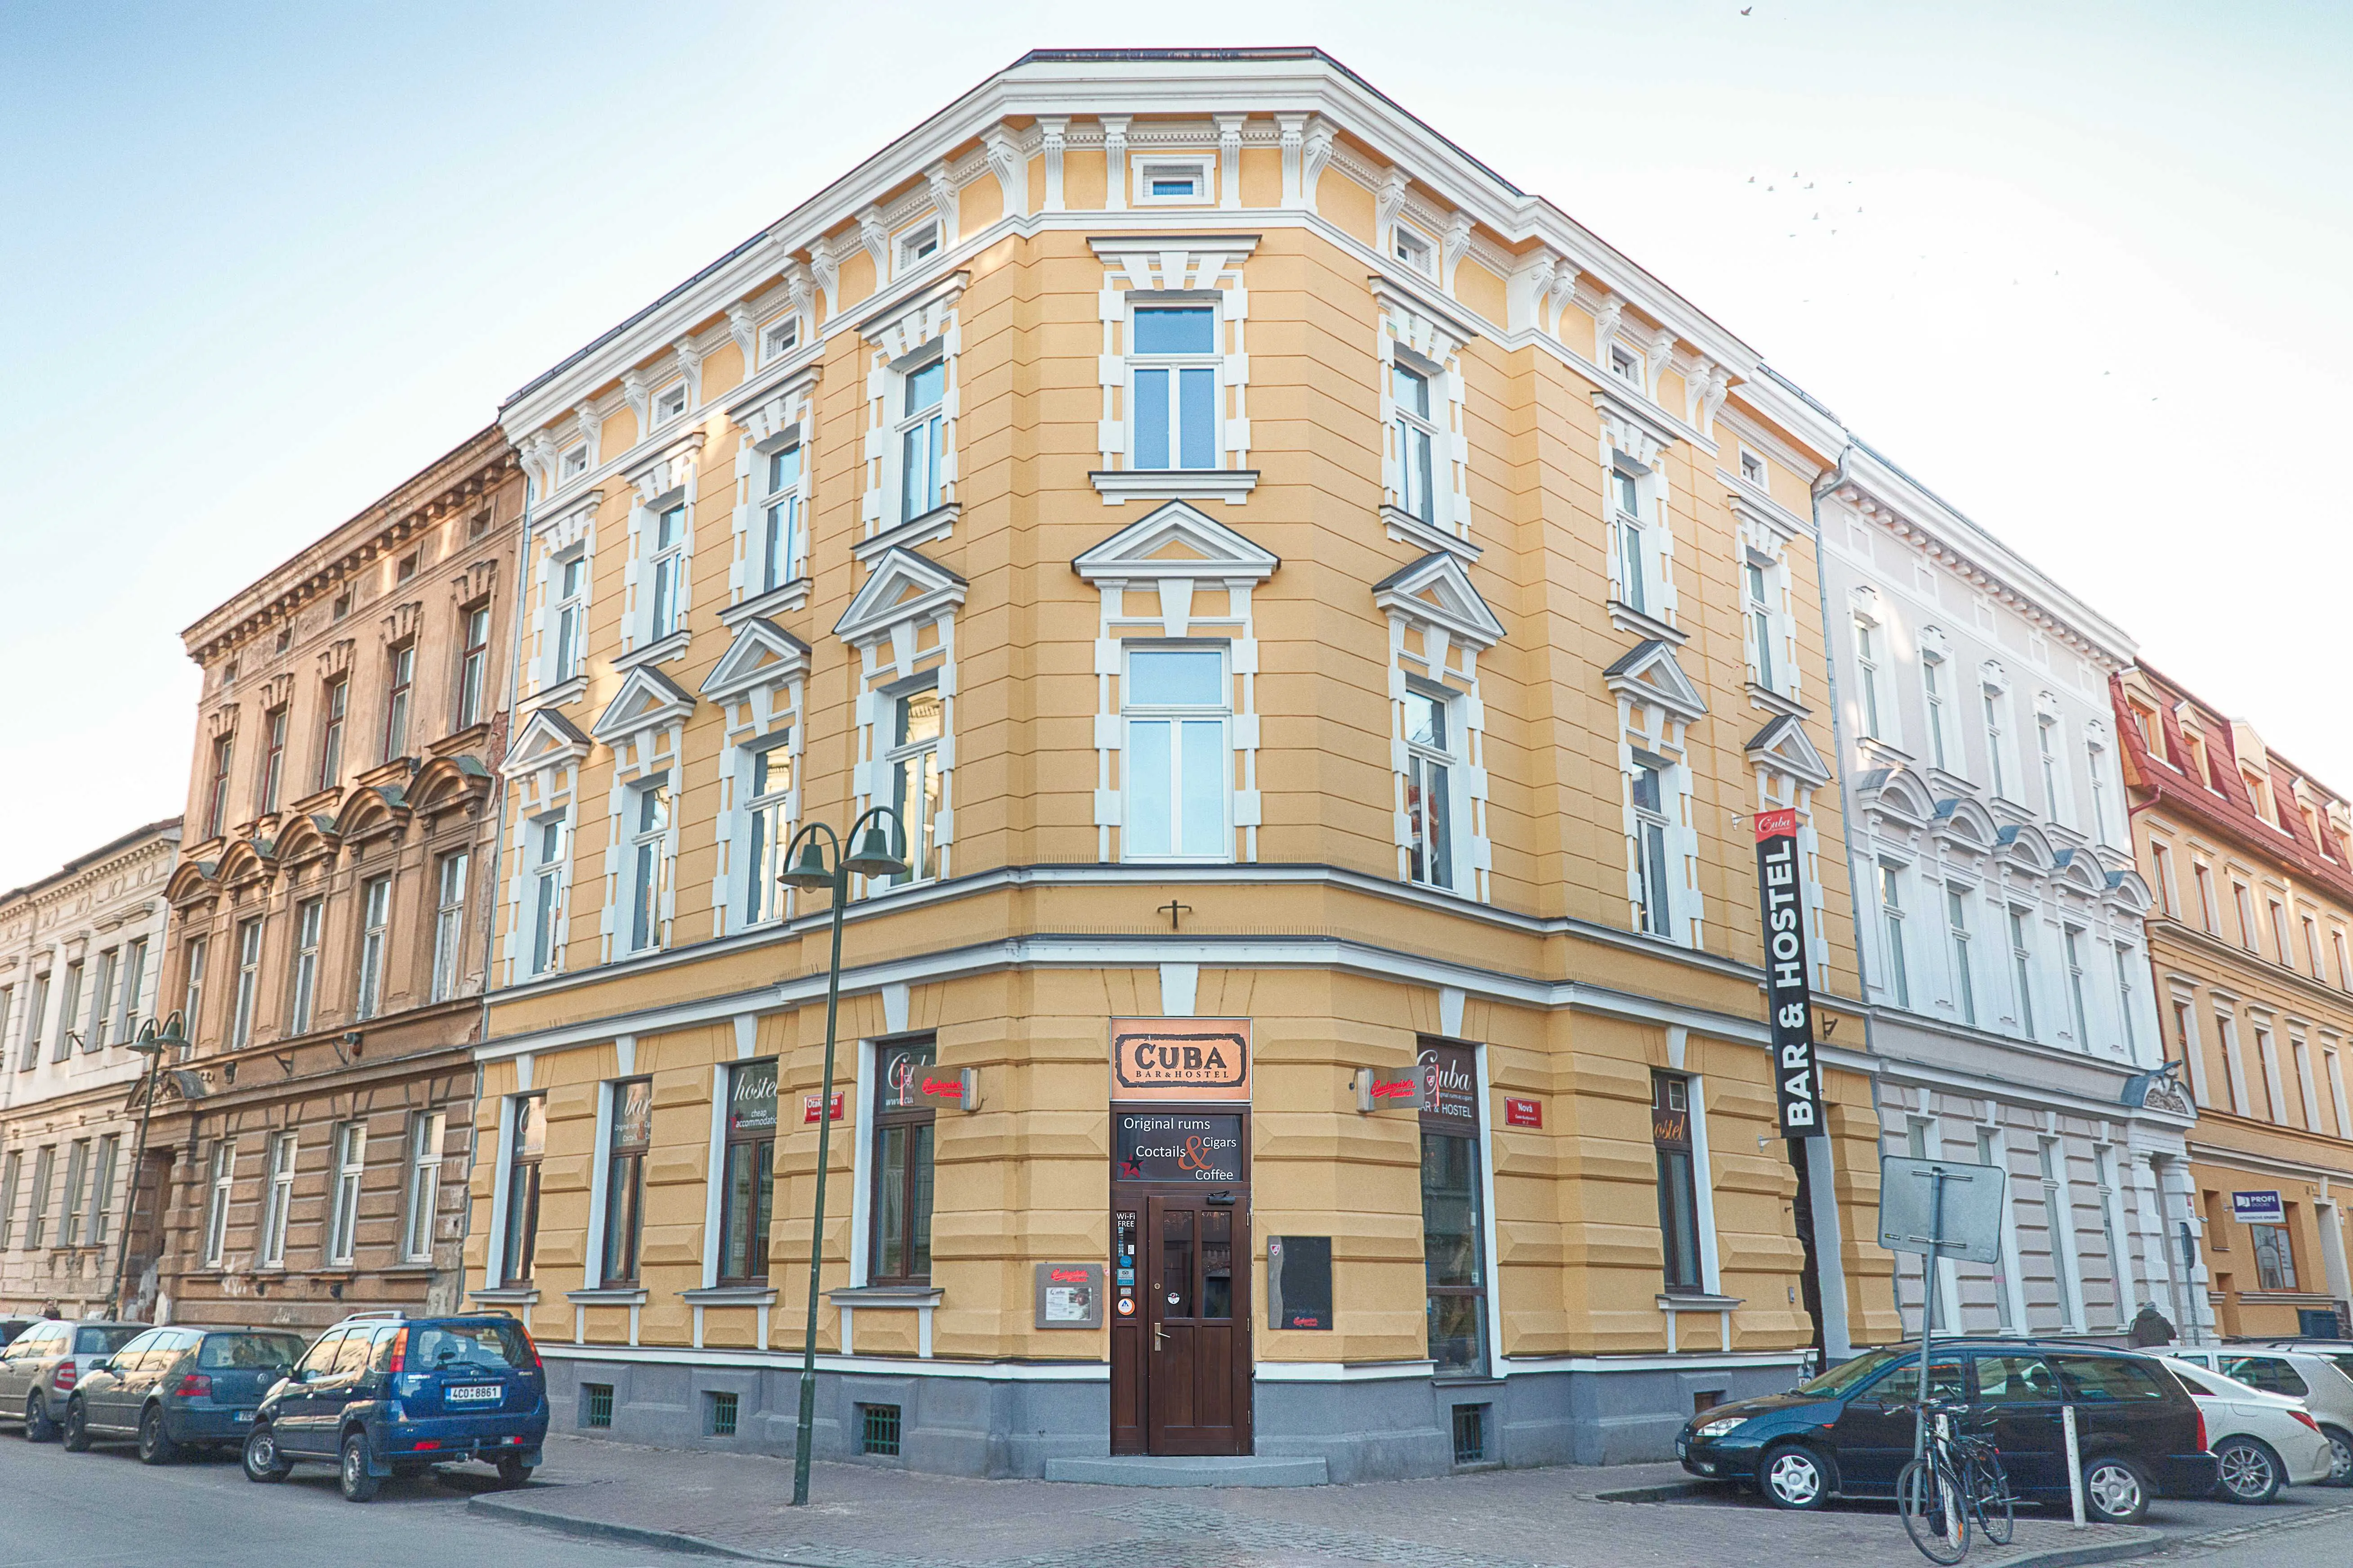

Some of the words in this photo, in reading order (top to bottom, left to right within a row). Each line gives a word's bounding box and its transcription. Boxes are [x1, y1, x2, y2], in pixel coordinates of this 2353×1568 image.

[1759, 816, 1790, 833] Cuba
[1766, 840, 1801, 987] HOSTEL
[1779, 1003, 1804, 1028] &
[1135, 1043, 1227, 1069] CUBA
[1782, 1043, 1814, 1126] BAR
[808, 1099, 838, 1108] Otakva
[1434, 1103, 1439, 1112] &
[1442, 1103, 1472, 1117] HOSTEL
[751, 1109, 767, 1118] cheap
[736, 1115, 777, 1128] accommodatio
[1124, 1118, 1174, 1131] Original
[1178, 1120, 1210, 1130] rums
[1655, 1113, 1685, 1141] ostel
[1203, 1137, 1237, 1149] Cigars
[1136, 1146, 1186, 1157] Coctails
[1178, 1135, 1213, 1170] &
[1195, 1170, 1233, 1180] Coffee
[476, 1387, 496, 1398] 8861
